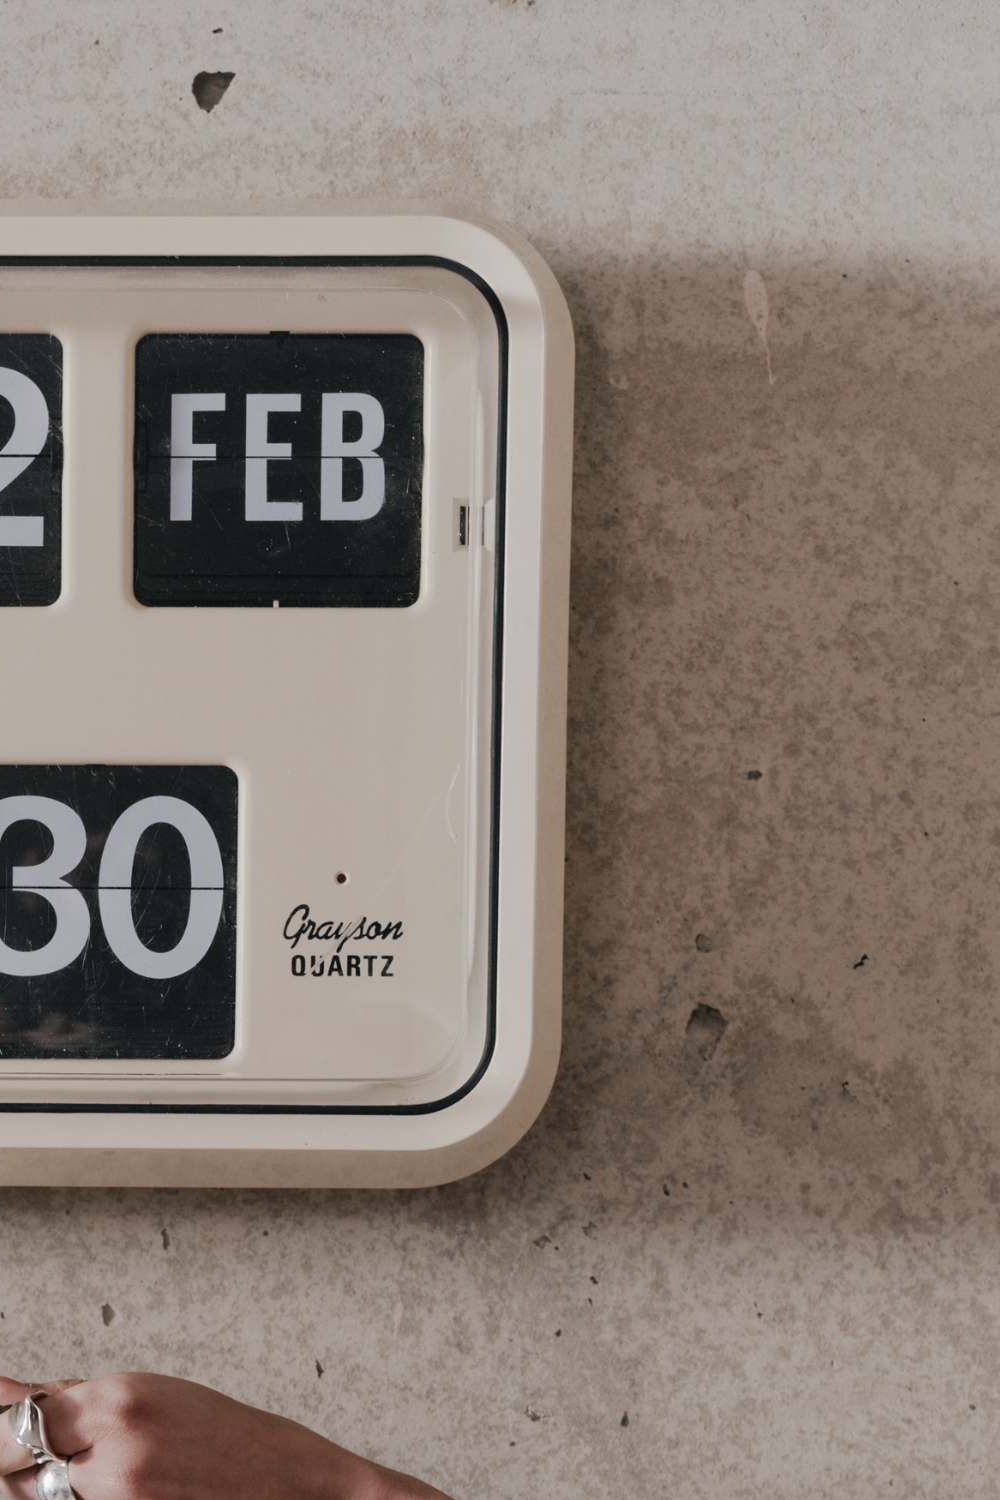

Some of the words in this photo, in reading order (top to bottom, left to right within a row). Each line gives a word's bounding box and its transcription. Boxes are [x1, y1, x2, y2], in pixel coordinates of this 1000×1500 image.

[169, 392, 386, 521] FEB
[283, 903, 404, 953] Grayson
[291, 954, 394, 977] QUARTZ
